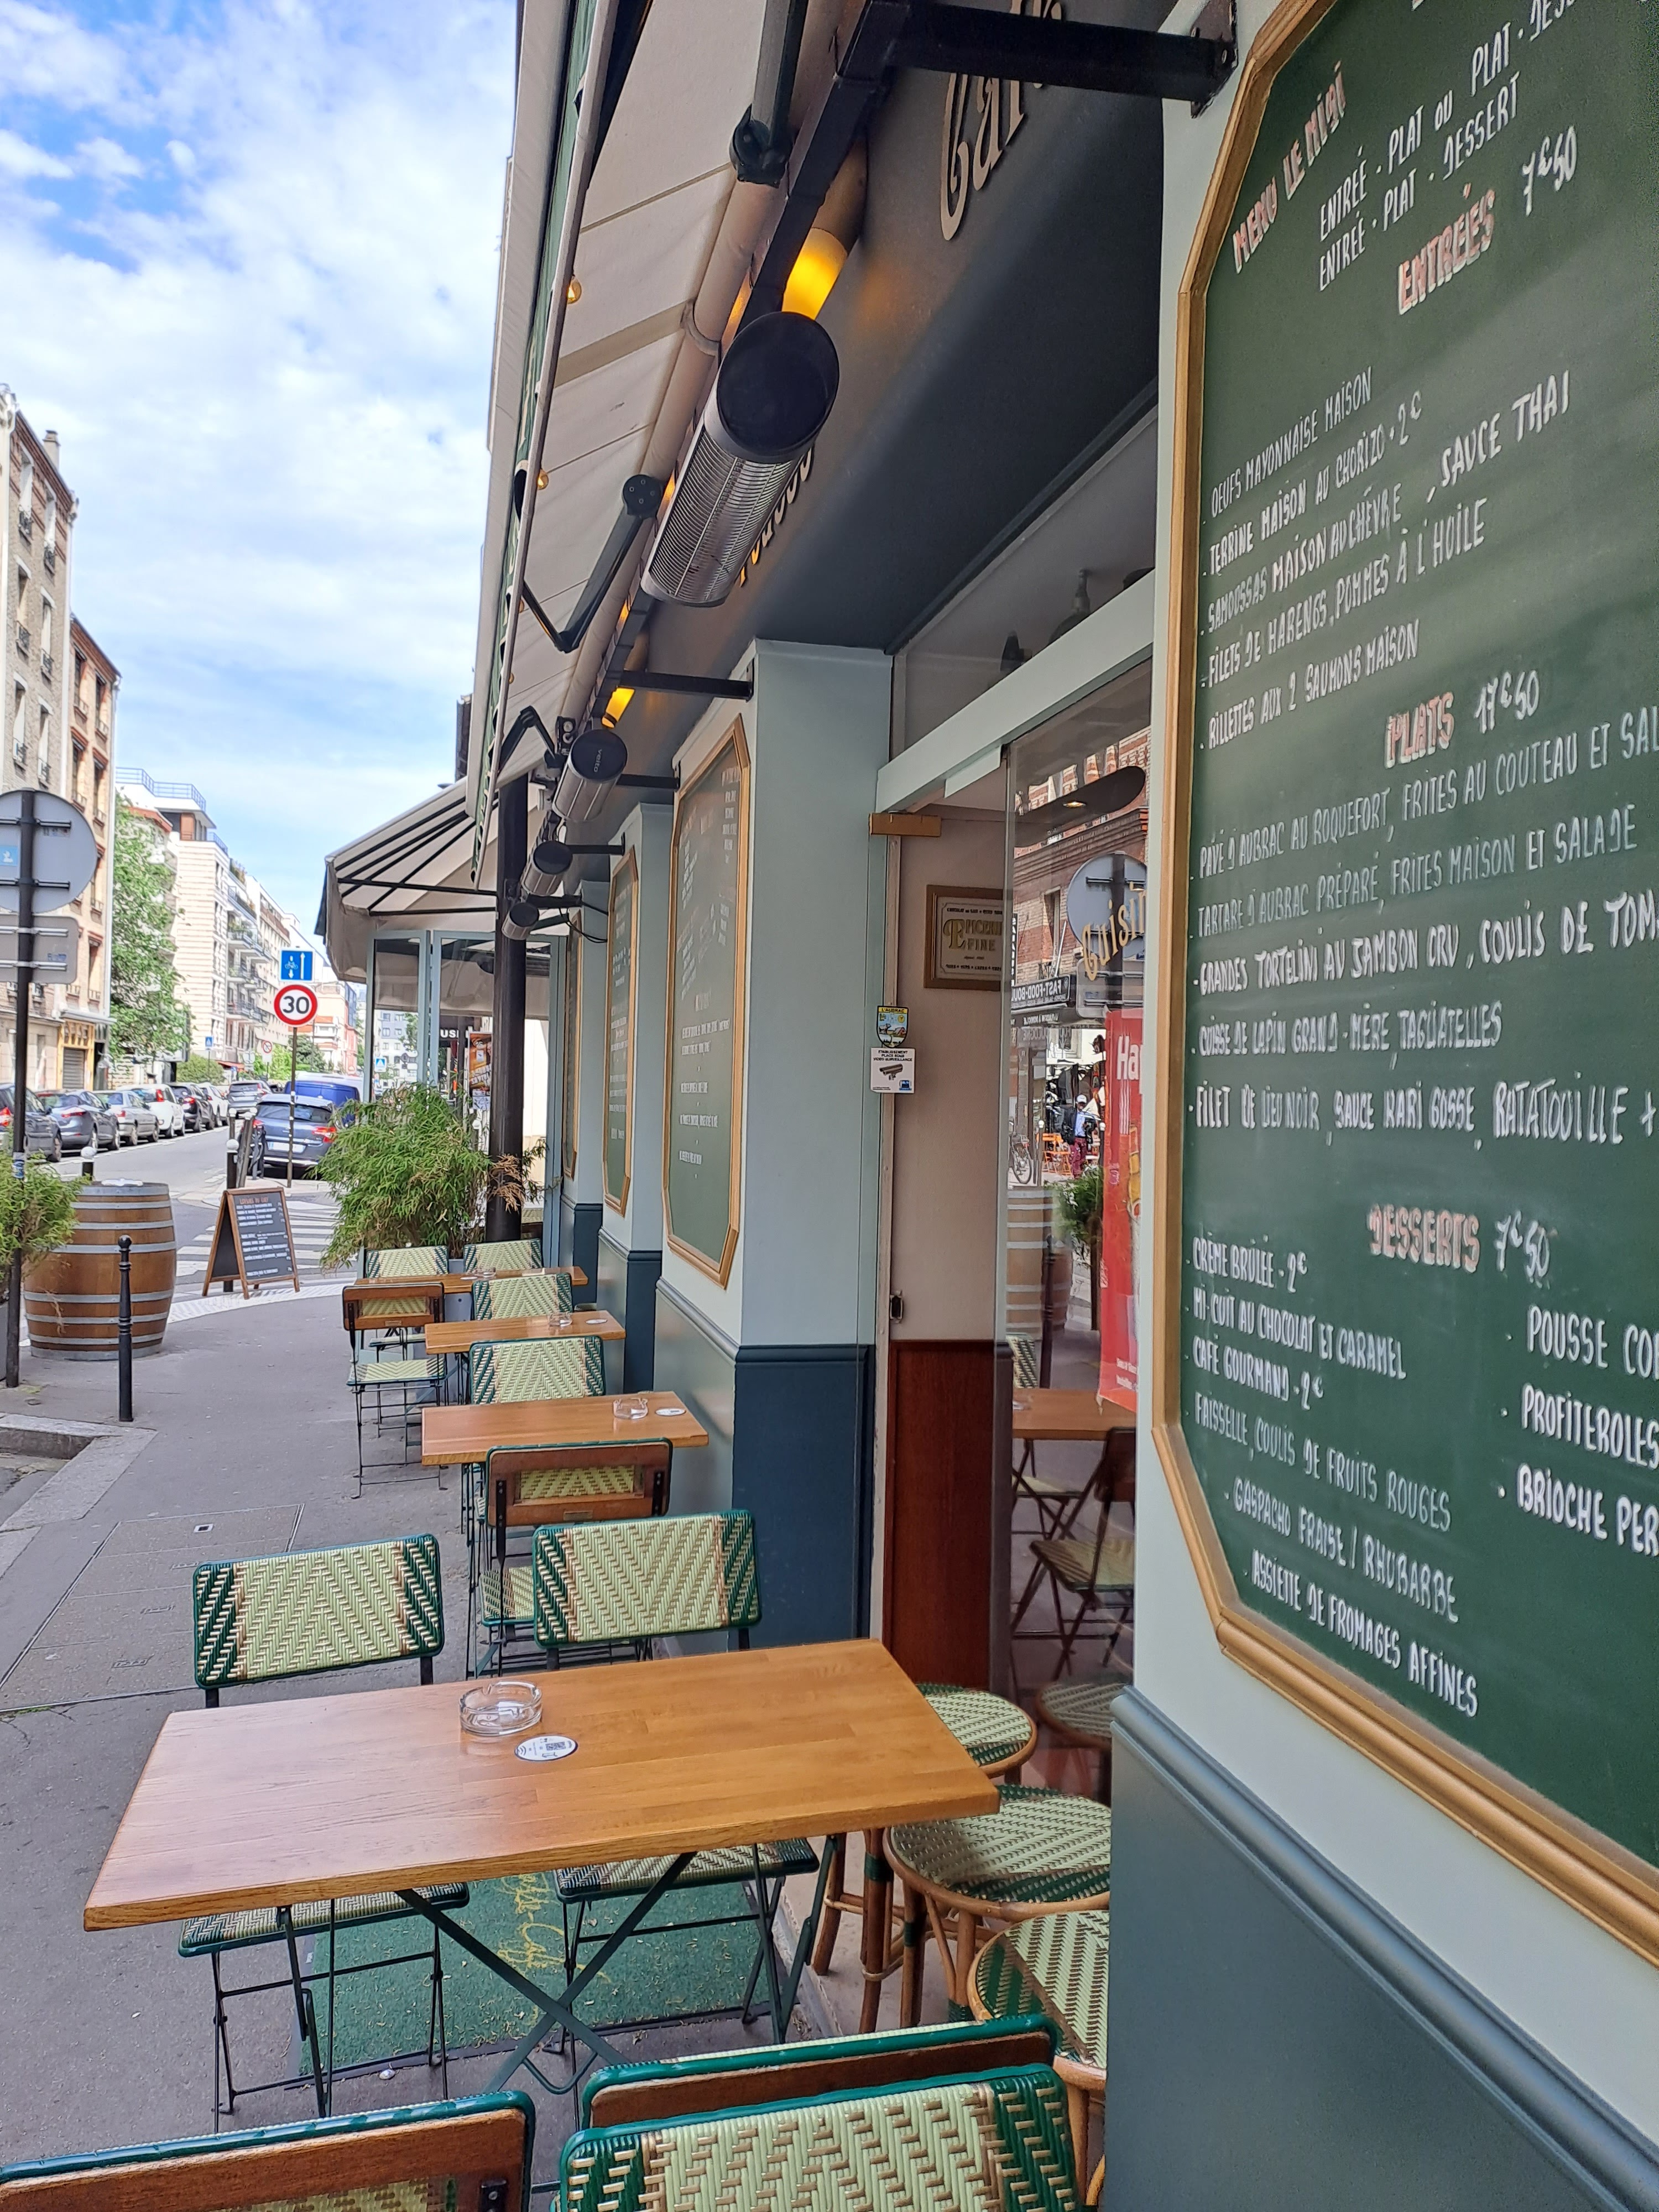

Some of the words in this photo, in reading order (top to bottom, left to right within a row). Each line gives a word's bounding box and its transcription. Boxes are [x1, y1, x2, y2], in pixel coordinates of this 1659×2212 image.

[1383, 168, 1417, 232] PLAT
[1443, 71, 1520, 181] DESSERT
[1388, 105, 1424, 175] PLAT
[1434, 90, 1453, 131] OU
[1470, 22, 1511, 97] PLAT
[1233, 176, 1277, 274] MENU
[1283, 139, 1305, 200] LE
[1208, 566, 1267, 634] SAMOUSSAS
[1272, 527, 1327, 593] MAISON
[1329, 519, 1348, 560] AU
[1441, 413, 1503, 488] SAUCE
[1511, 369, 1569, 442] THAI
[1209, 521, 1254, 575] TERRINE
[1261, 480, 1307, 541] MAISON
[1315, 466, 1329, 505] AU
[1335, 424, 1385, 489] CHORIZO
[1211, 468, 1242, 518] OEUFS
[1245, 409, 1318, 492] MAYONNAISE
[1325, 366, 1372, 432] MAISON
[1208, 641, 1241, 688] FILETS
[1245, 630, 1261, 668] DE
[1336, 553, 1390, 619] POMMES
[1208, 697, 1255, 750] RILLETTES
[1260, 687, 1282, 724] AUX
[1287, 671, 1297, 712] 2
[1304, 644, 1362, 703] SAUMONS
[1366, 618, 1420, 677] MAISON
[1386, 691, 1454, 768] PLATS
[1290, 815, 1308, 850] AU
[1402, 769, 1457, 821] FRITES
[1464, 759, 1487, 805] AU
[1496, 731, 1578, 796] COUTEAU
[1590, 722, 1611, 769] ET
[1198, 898, 1244, 938] TARTARE
[1390, 849, 1442, 895] FRITES
[1449, 834, 1515, 885] MAISON
[1527, 830, 1546, 870] ET
[1554, 803, 1638, 864] SALADE
[1200, 956, 1249, 995] GRANDES
[1324, 940, 1345, 981] AU
[1350, 927, 1418, 978] JAMBON
[1479, 899, 1546, 964] COULIS
[1561, 900, 1594, 954] DE
[1603, 887, 1659, 948] TOM
[283, 995, 310, 1014] 30
[1233, 1020, 1248, 1055] DE
[1251, 1011, 1287, 1055] LAPIN
[1397, 999, 1503, 1050] TAGLIATELLES
[1196, 1079, 1232, 1128] FILET
[1261, 1084, 1283, 1128] LIEU
[1334, 1089, 1375, 1131] SAUCE
[1383, 1080, 1424, 1131] KARI
[1494, 1071, 1630, 1144] RATATOUILLE
[1368, 1203, 1480, 1274] DESSERTS
[1223, 1345, 1290, 1402] GOURMAND
[1238, 1300, 1256, 1335] AU
[1257, 1302, 1316, 1353] CHOCOLAT
[1317, 1322, 1334, 1360] ET
[1335, 1327, 1407, 1380] CARAMEL
[1527, 1305, 1608, 1369] POUSSE
[1254, 1416, 1296, 1468] COULIS
[1302, 1437, 1321, 1480] DE
[1327, 1447, 1379, 1503] FRUITS
[1386, 1469, 1452, 1533] ROUGES
[1516, 1463, 1608, 1541] BRIOCHE
[1233, 1477, 1292, 1538] GASPACHO
[1297, 1505, 1347, 1567] FRAISE
[1363, 1534, 1459, 1624] RHUBARBE
[1250, 1548, 1302, 1612] ASSIETTE
[1306, 1582, 1326, 1627] DE
[1327, 1593, 1401, 1670] FROMAGES
